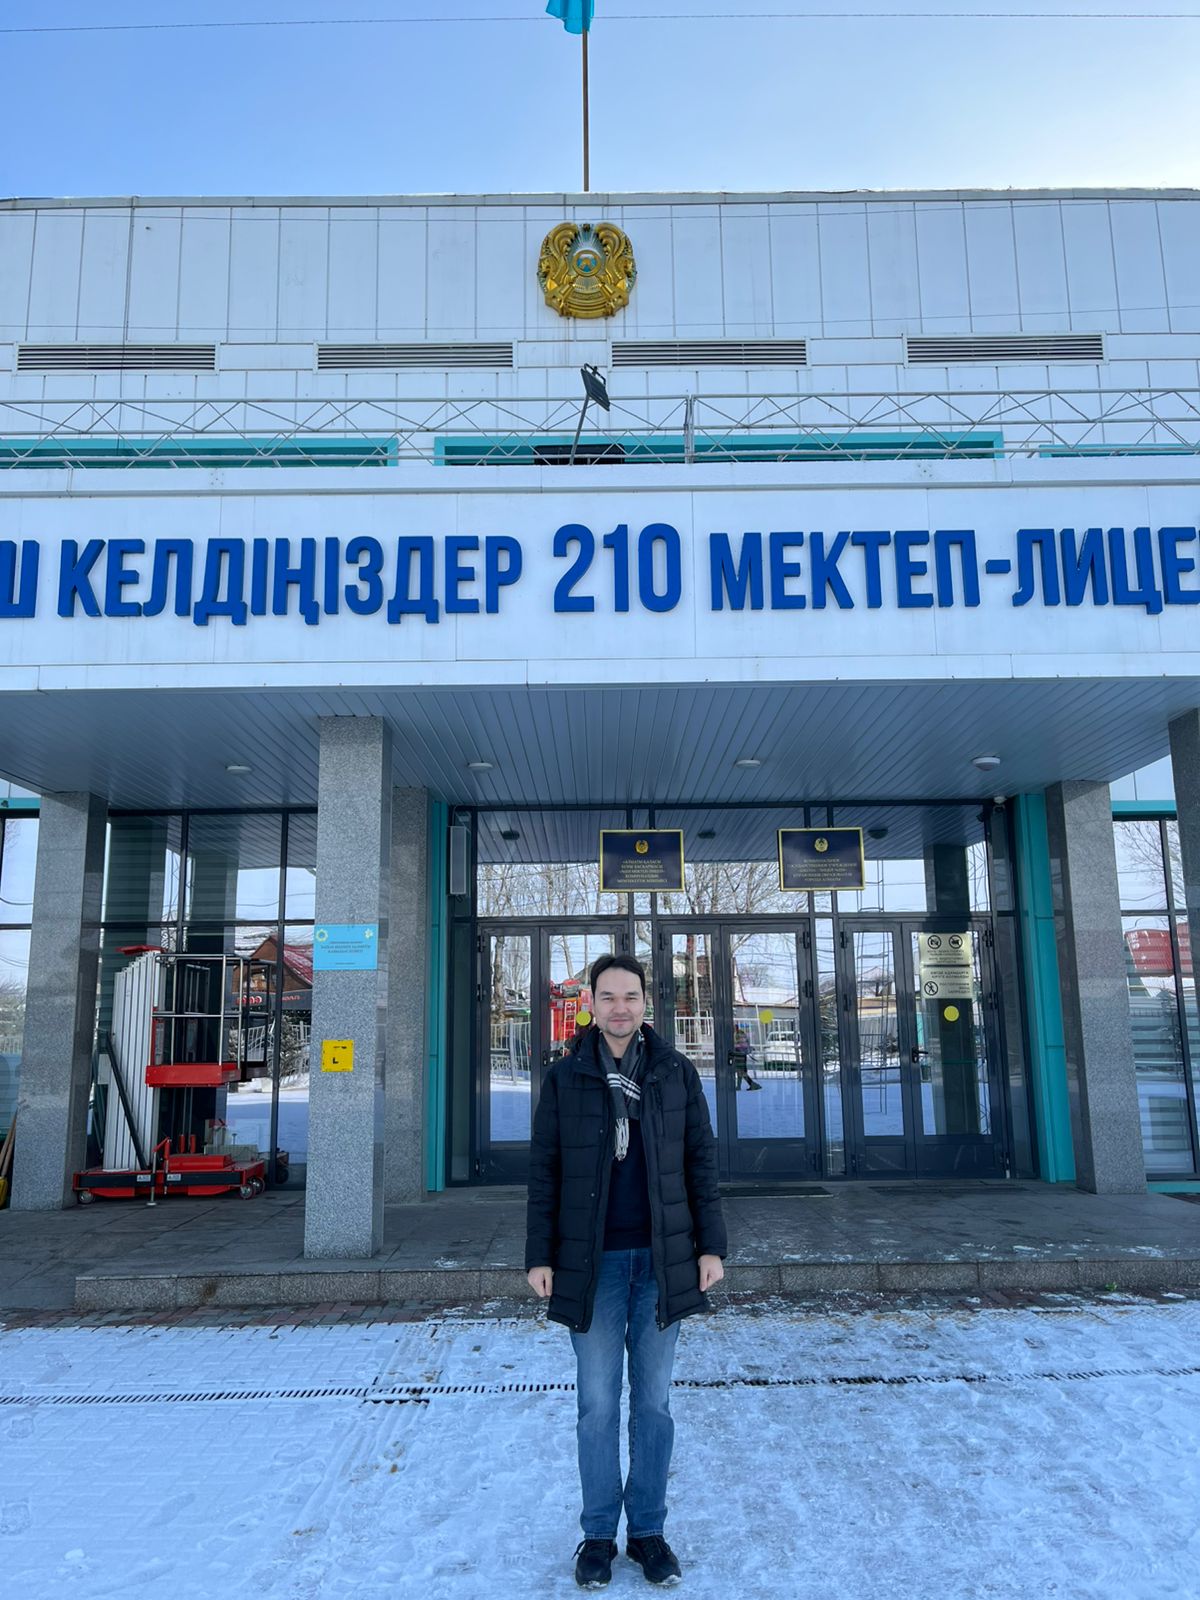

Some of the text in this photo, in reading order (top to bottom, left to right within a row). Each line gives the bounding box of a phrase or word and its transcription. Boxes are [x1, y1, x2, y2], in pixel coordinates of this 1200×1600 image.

[57, 536, 523, 626] КЕЛДІҢІЗДЕР
[552, 523, 682, 613] 210
[709, 527, 1200, 615] МЕКТЕП-ЛИЦЕ
